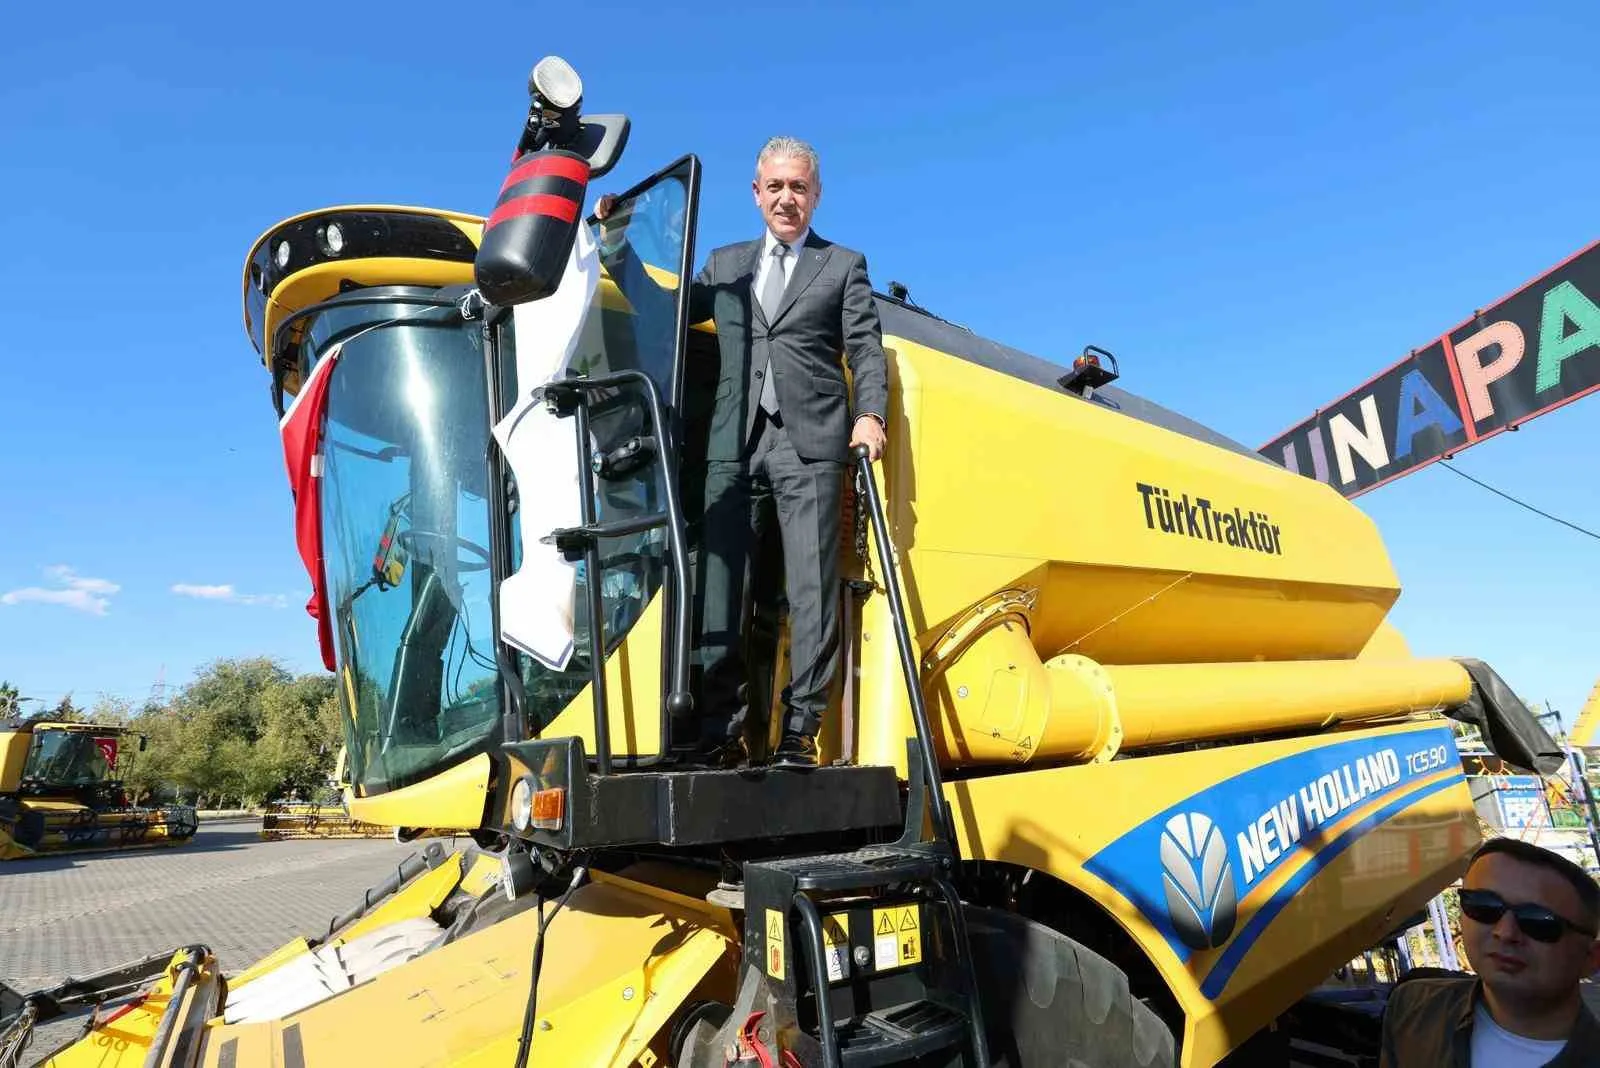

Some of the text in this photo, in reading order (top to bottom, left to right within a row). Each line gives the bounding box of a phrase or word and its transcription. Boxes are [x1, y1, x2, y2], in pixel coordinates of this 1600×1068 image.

[1136, 482, 1282, 555] TürkTraktör
[1236, 793, 1302, 885] NEW
[1299, 748, 1401, 831] HOLLAND
